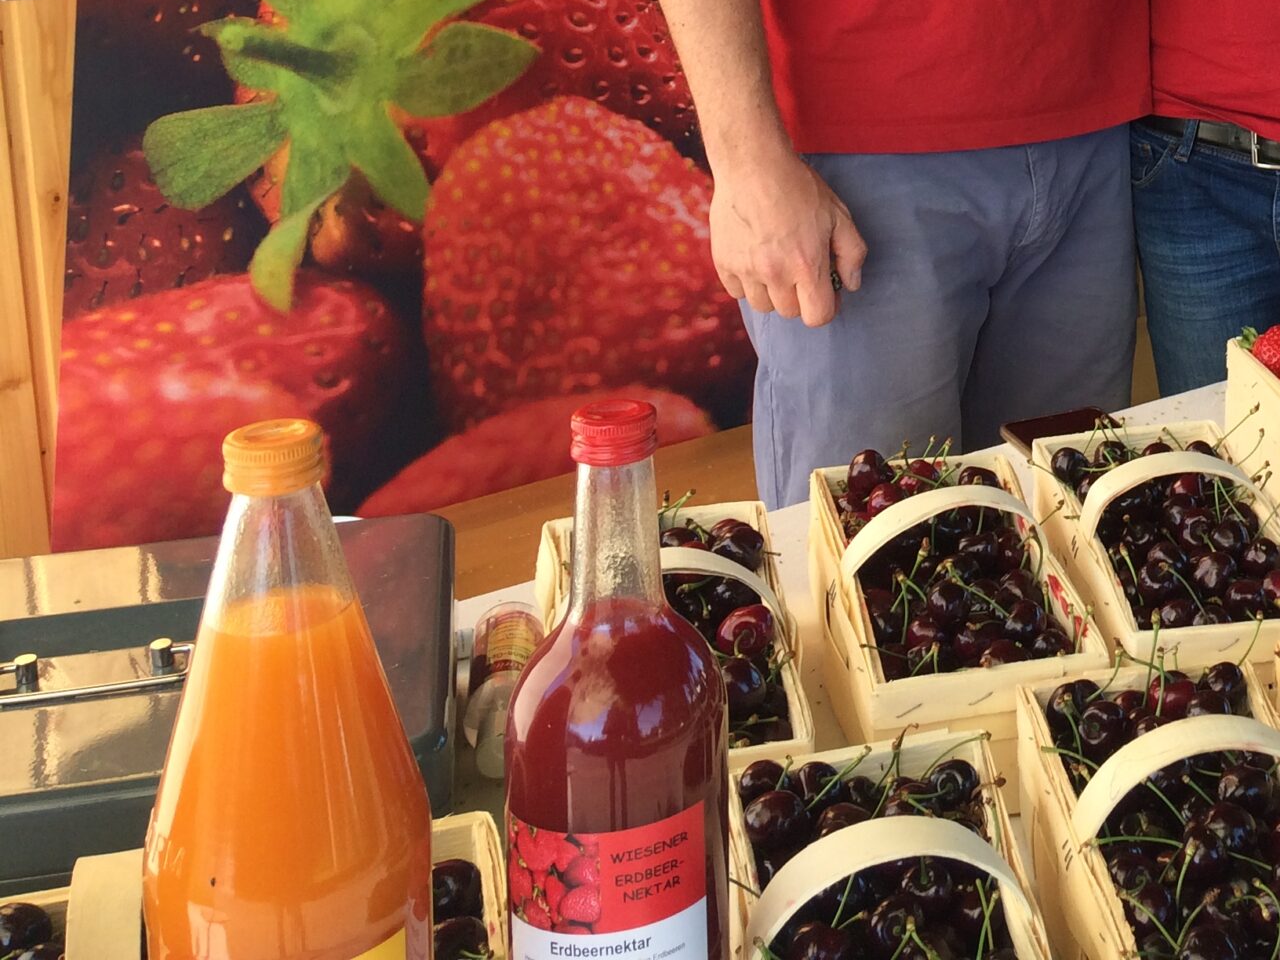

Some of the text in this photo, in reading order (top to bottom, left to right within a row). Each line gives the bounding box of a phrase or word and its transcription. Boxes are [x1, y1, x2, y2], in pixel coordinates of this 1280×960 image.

[610, 831, 689, 865] WIESENER
[614, 858, 685, 887] ERDBEER-
[622, 875, 681, 904] NEKTAR
[550, 936, 652, 958] Erdbeernektar
